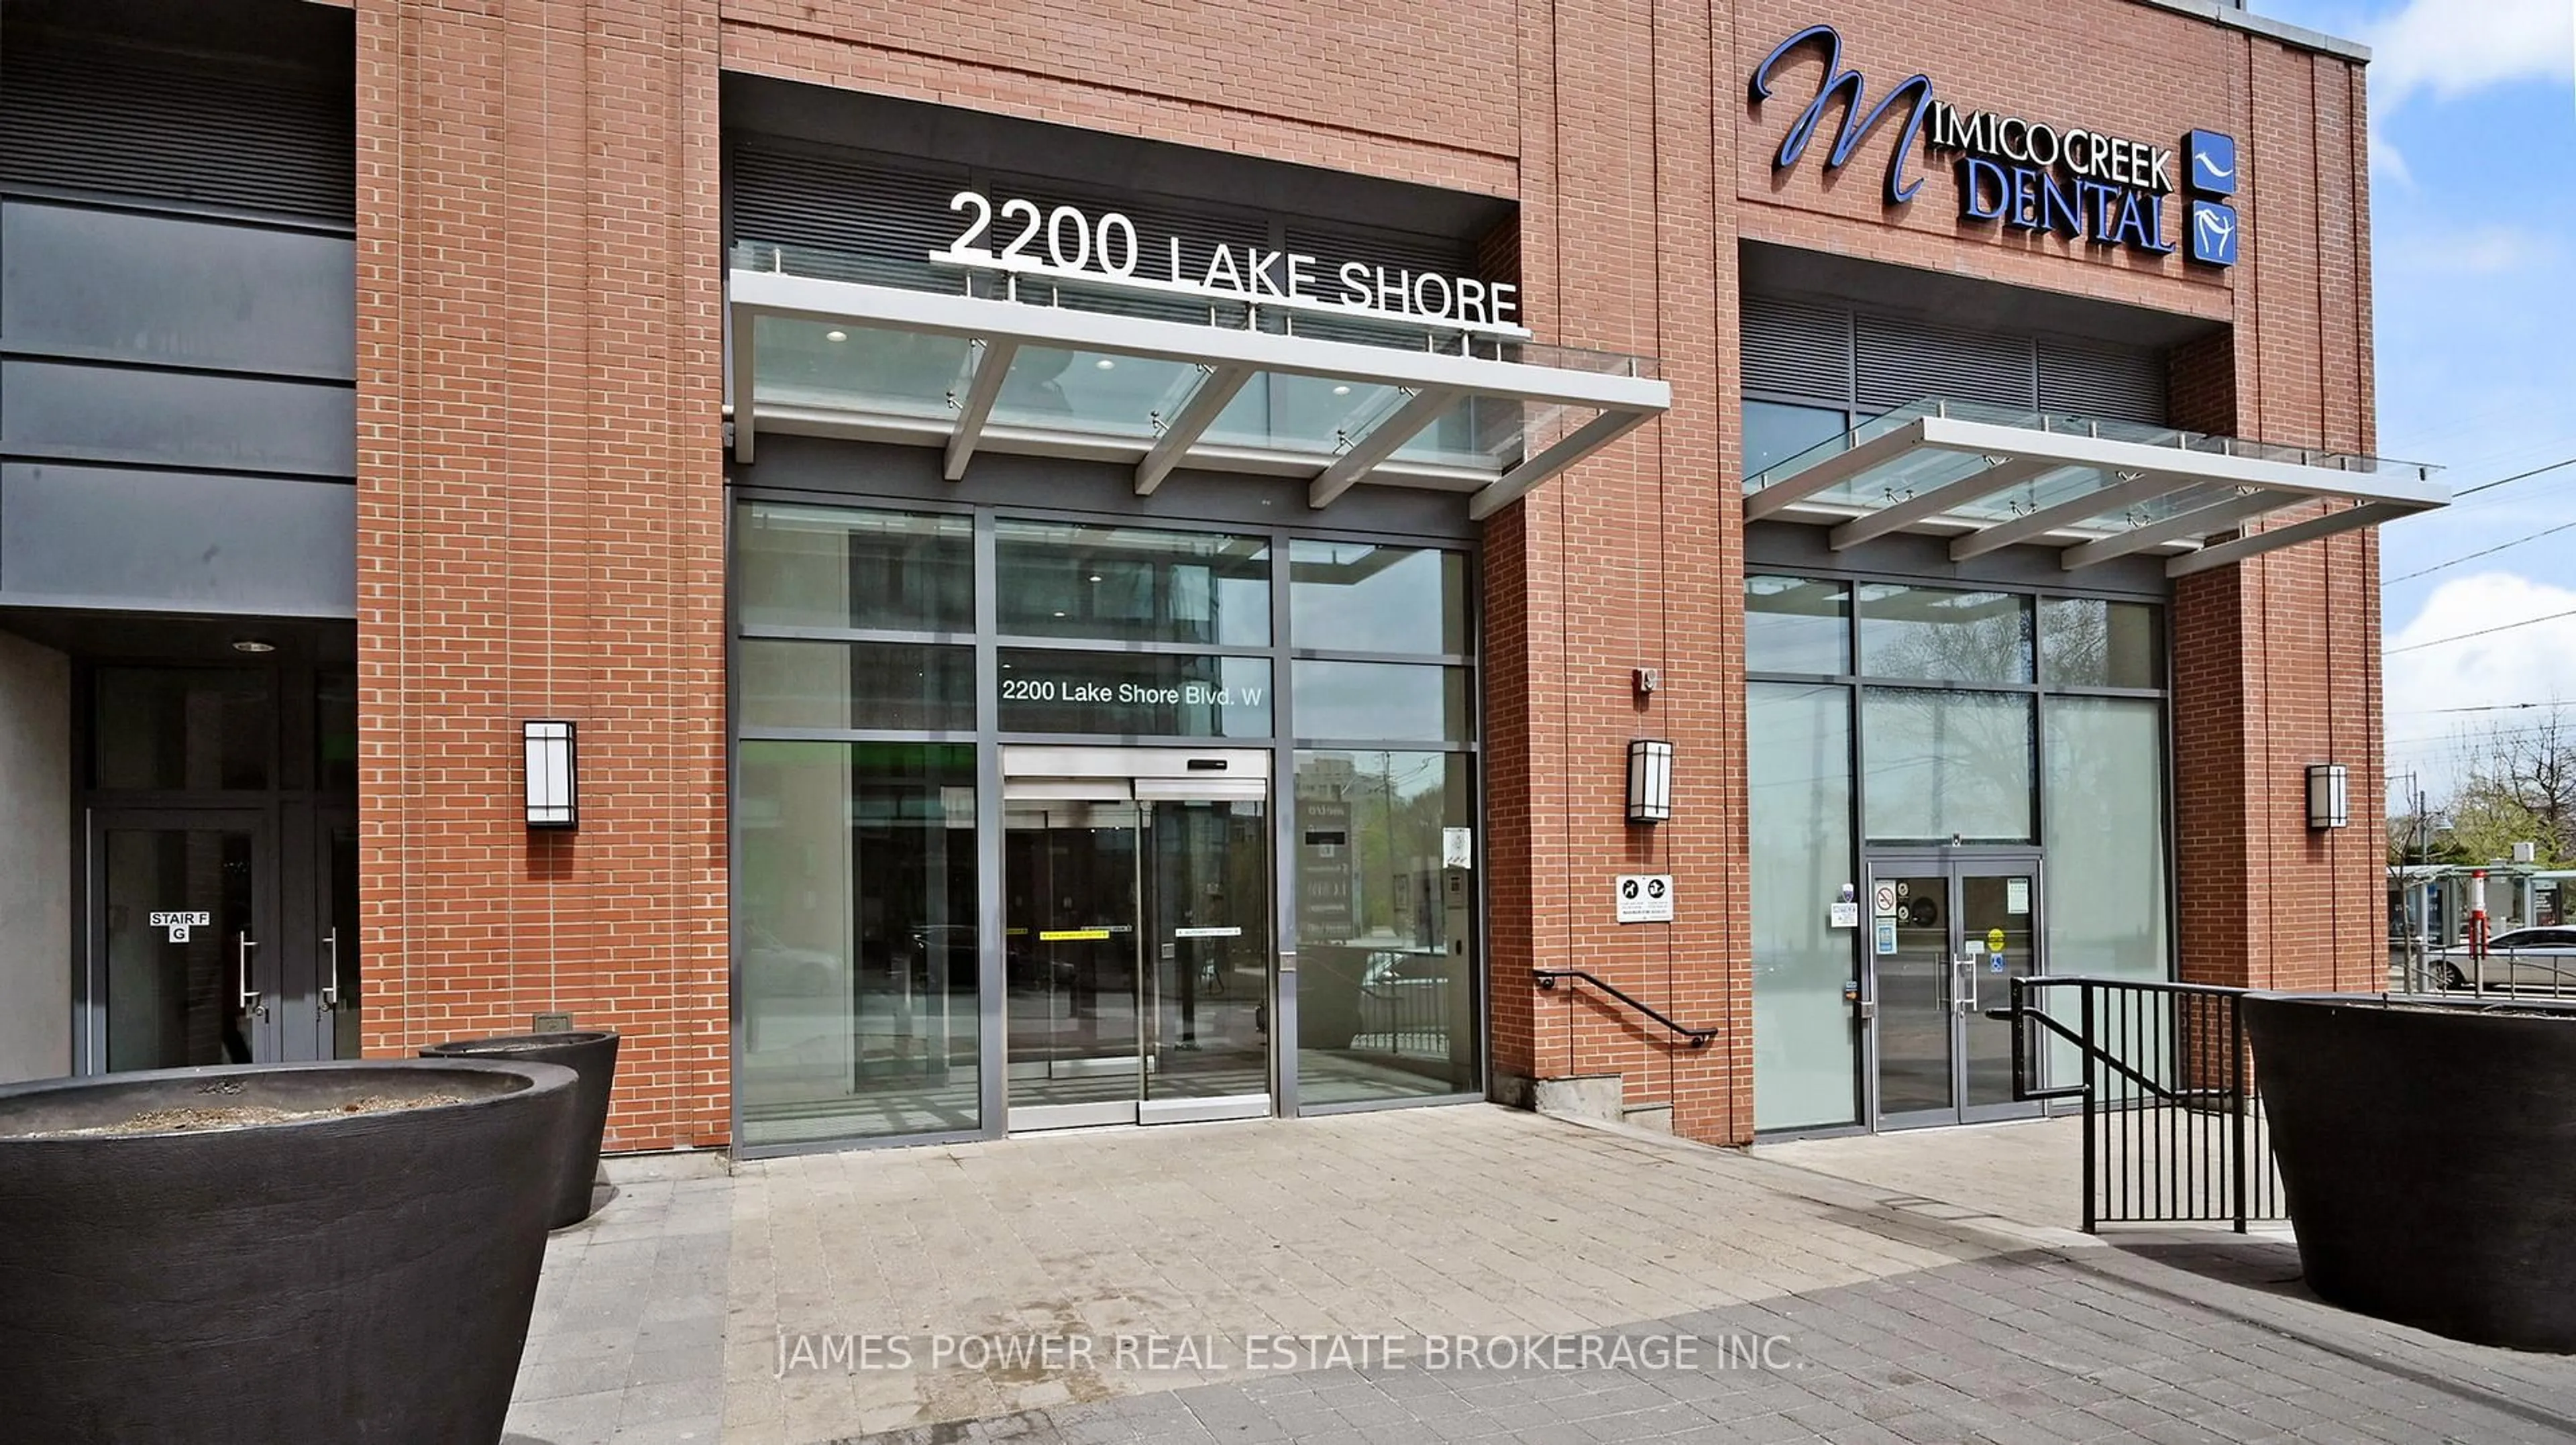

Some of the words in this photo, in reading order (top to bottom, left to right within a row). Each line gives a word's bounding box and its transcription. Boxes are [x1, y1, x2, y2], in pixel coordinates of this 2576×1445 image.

[2063, 128, 2175, 192] CREEK
[1966, 156, 2176, 253] DENTAL
[949, 191, 1138, 277] 2200
[1170, 235, 1317, 299] LAKE
[1340, 261, 1519, 327] SHORE
[1002, 680, 1055, 701] 2200
[1062, 682, 1112, 702] Lake
[1118, 683, 1179, 704] Shore
[1185, 686, 1235, 706] Blvd.
[1241, 688, 1262, 706] W
[152, 913, 195, 924] STAIR
[199, 913, 208, 924] F
[173, 928, 185, 940] G
